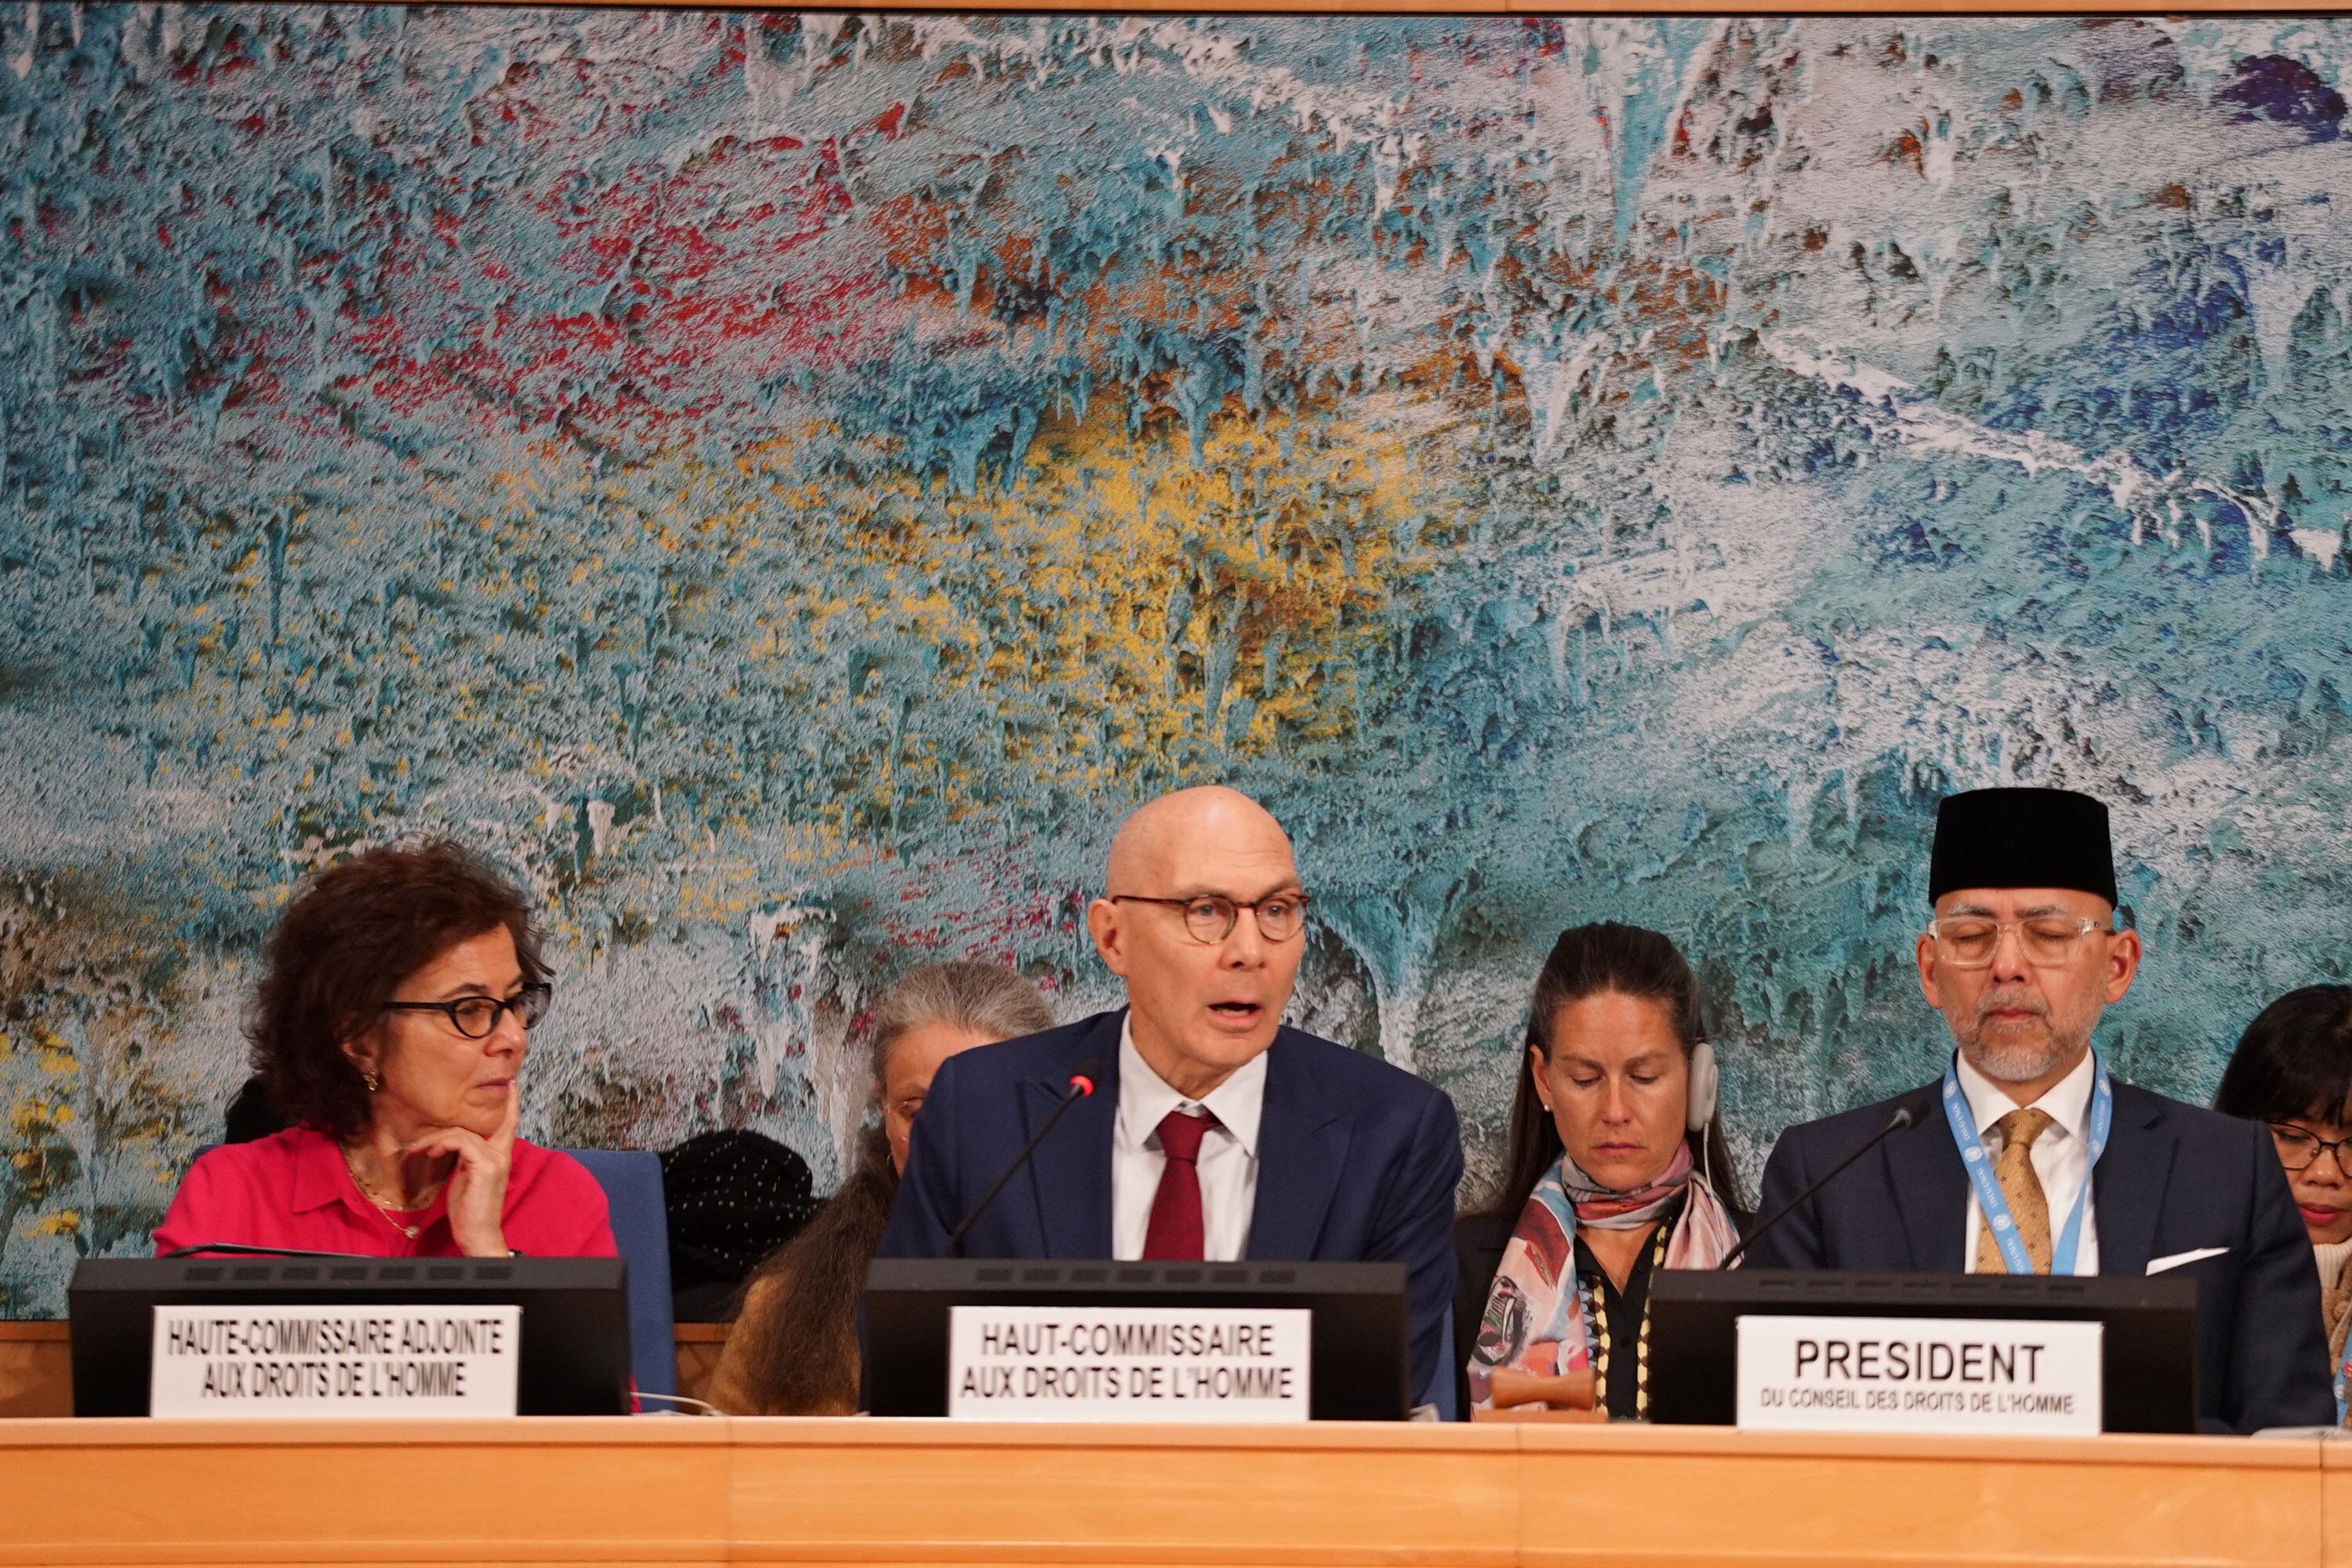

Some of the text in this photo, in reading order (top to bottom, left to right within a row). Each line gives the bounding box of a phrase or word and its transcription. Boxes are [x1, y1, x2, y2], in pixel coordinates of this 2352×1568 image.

[168, 1319, 503, 1355] HAUTE-COMMISSAIRE ADJOINTE
[982, 1323, 1275, 1356] HAUT-COMMISSAIRE
[1795, 1339, 2045, 1383] PRESIDENT
[201, 1362, 466, 1398] AUX DROITS DE L'HOMME
[960, 1366, 1294, 1399] AUX DROITS DE L'HOMME
[1761, 1388, 2075, 1414] DU CONSEIL DES DROITS DE L'HOMME
